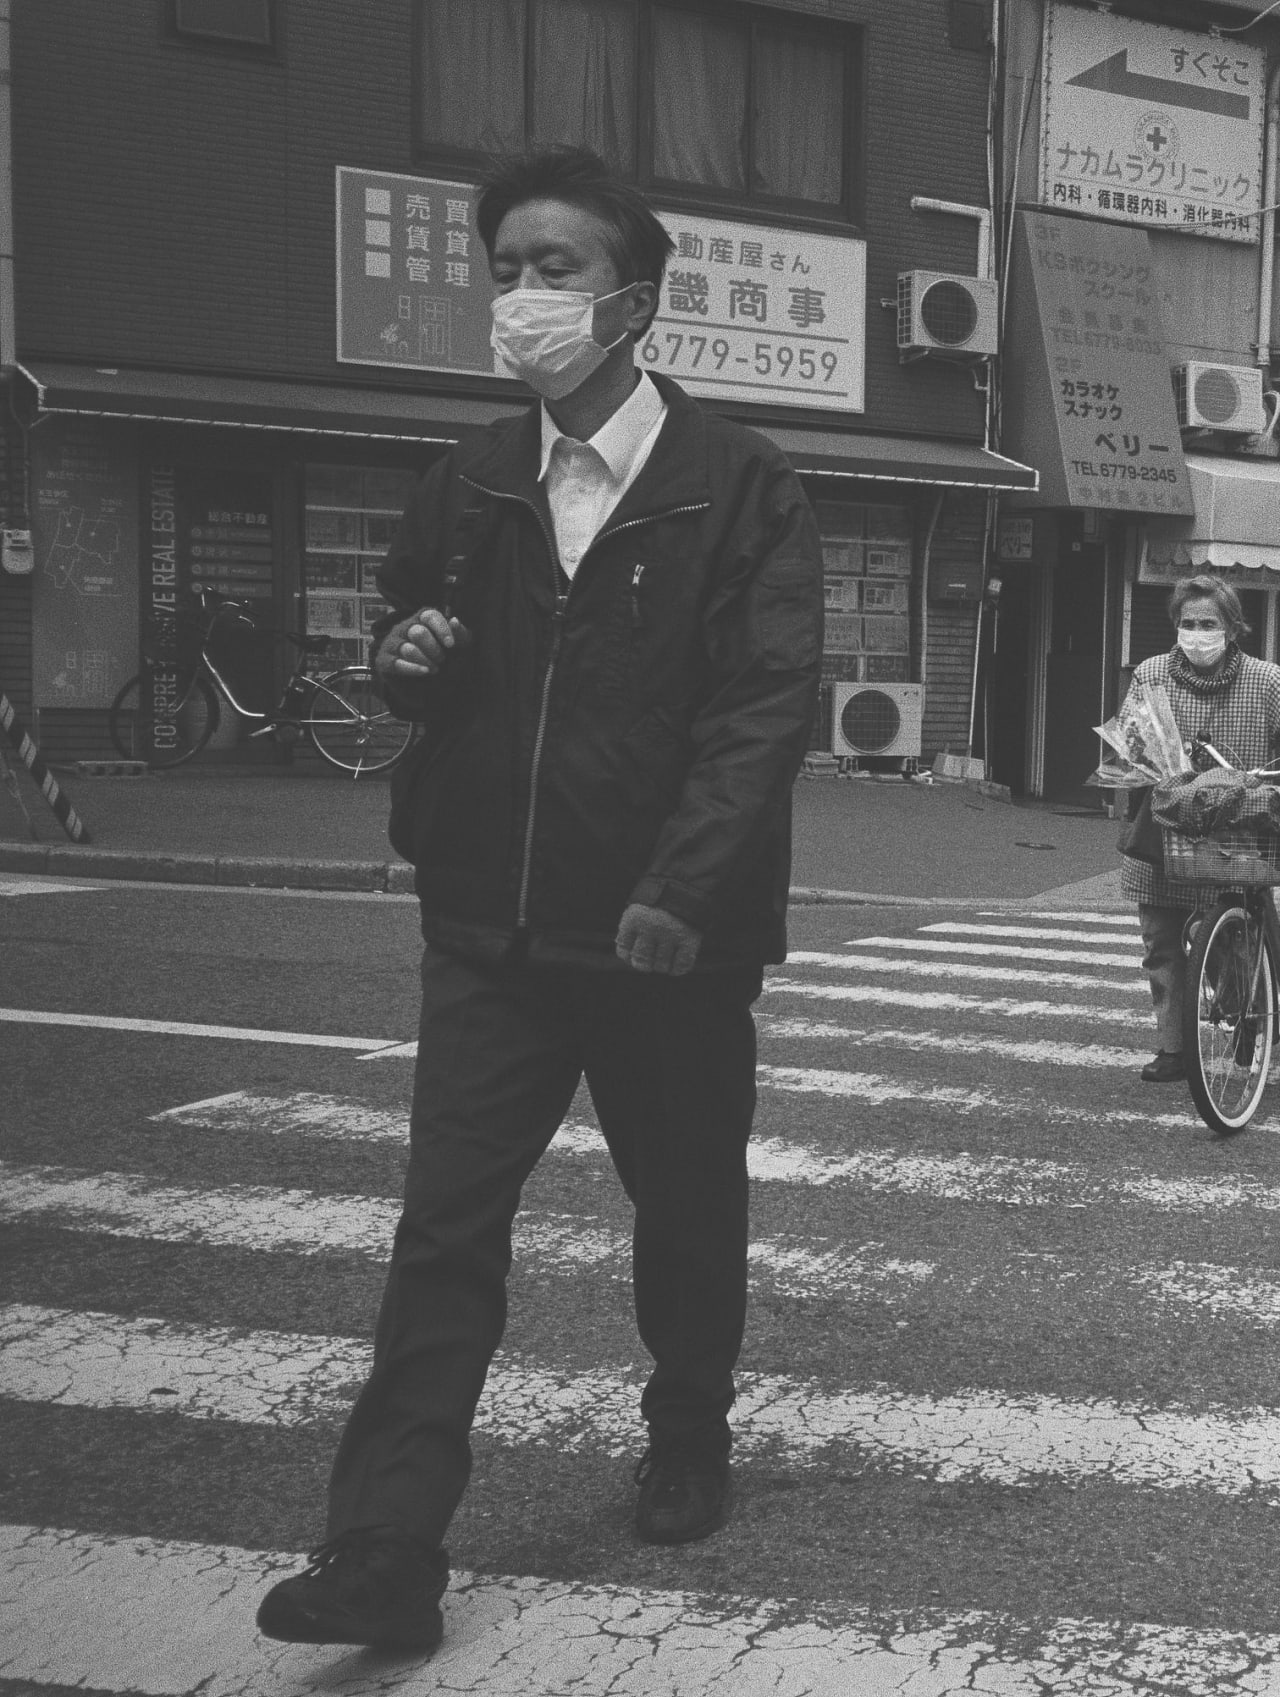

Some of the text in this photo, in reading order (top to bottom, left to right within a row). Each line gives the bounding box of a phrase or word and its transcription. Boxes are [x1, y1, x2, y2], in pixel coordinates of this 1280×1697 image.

[1057, 142, 1251, 201] ナカムラクリニック
[641, 331, 838, 383] 6779-5959
[1060, 378, 1120, 401] カラオケ
[1063, 400, 1123, 422] スナック
[1094, 433, 1170, 457] ベリー
[151, 466, 176, 533] ESTATE
[152, 539, 176, 586] REAL
